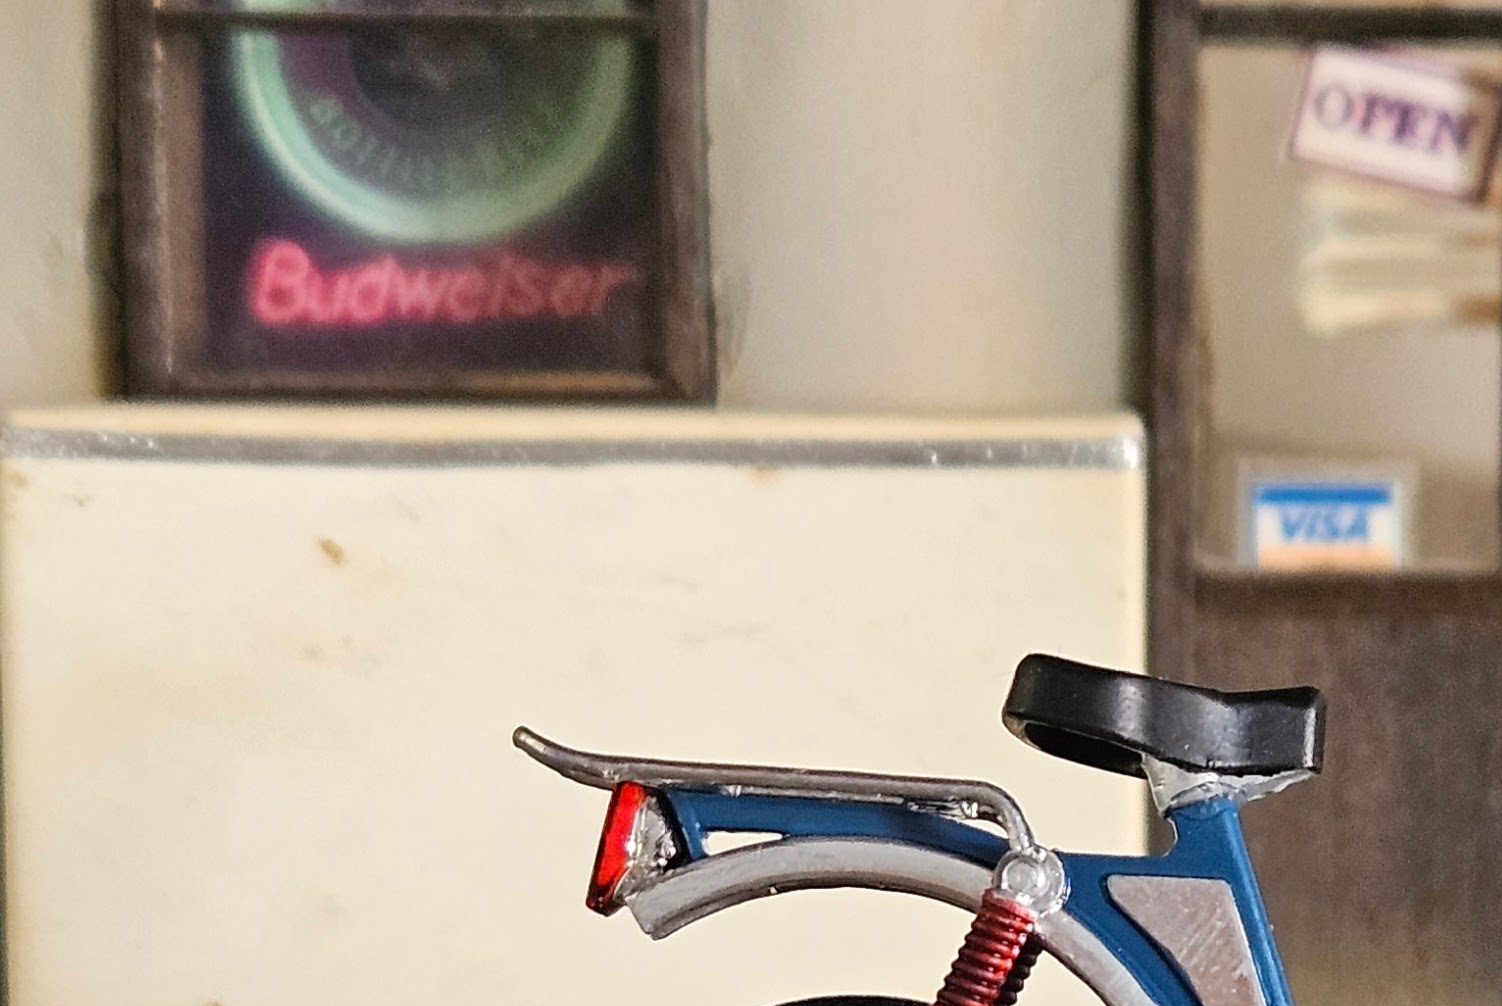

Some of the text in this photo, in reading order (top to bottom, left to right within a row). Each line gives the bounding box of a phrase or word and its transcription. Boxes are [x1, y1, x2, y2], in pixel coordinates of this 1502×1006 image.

[1313, 84, 1480, 154] OPEN
[250, 238, 640, 324] Budweiser
[1279, 506, 1370, 543] VISA
